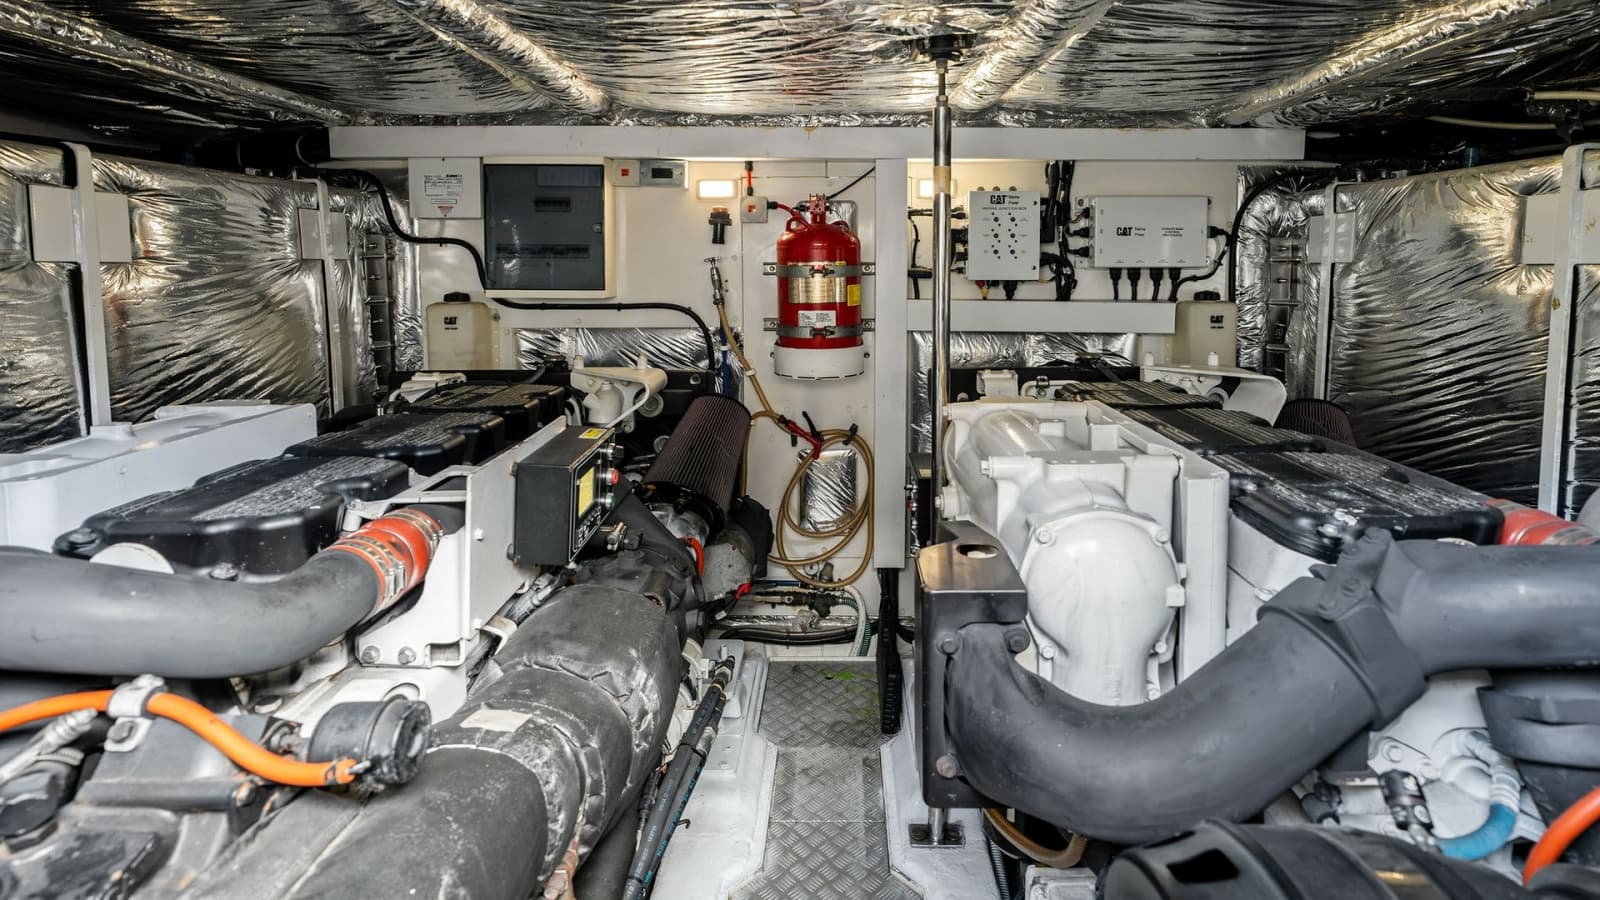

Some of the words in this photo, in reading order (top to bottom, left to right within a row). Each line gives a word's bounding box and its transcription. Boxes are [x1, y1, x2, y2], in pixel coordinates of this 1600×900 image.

[990, 194, 1008, 204] CAT
[1116, 227, 1133, 236] CAT
[443, 316, 458, 325] CAT
[1210, 315, 1224, 323] CAT
